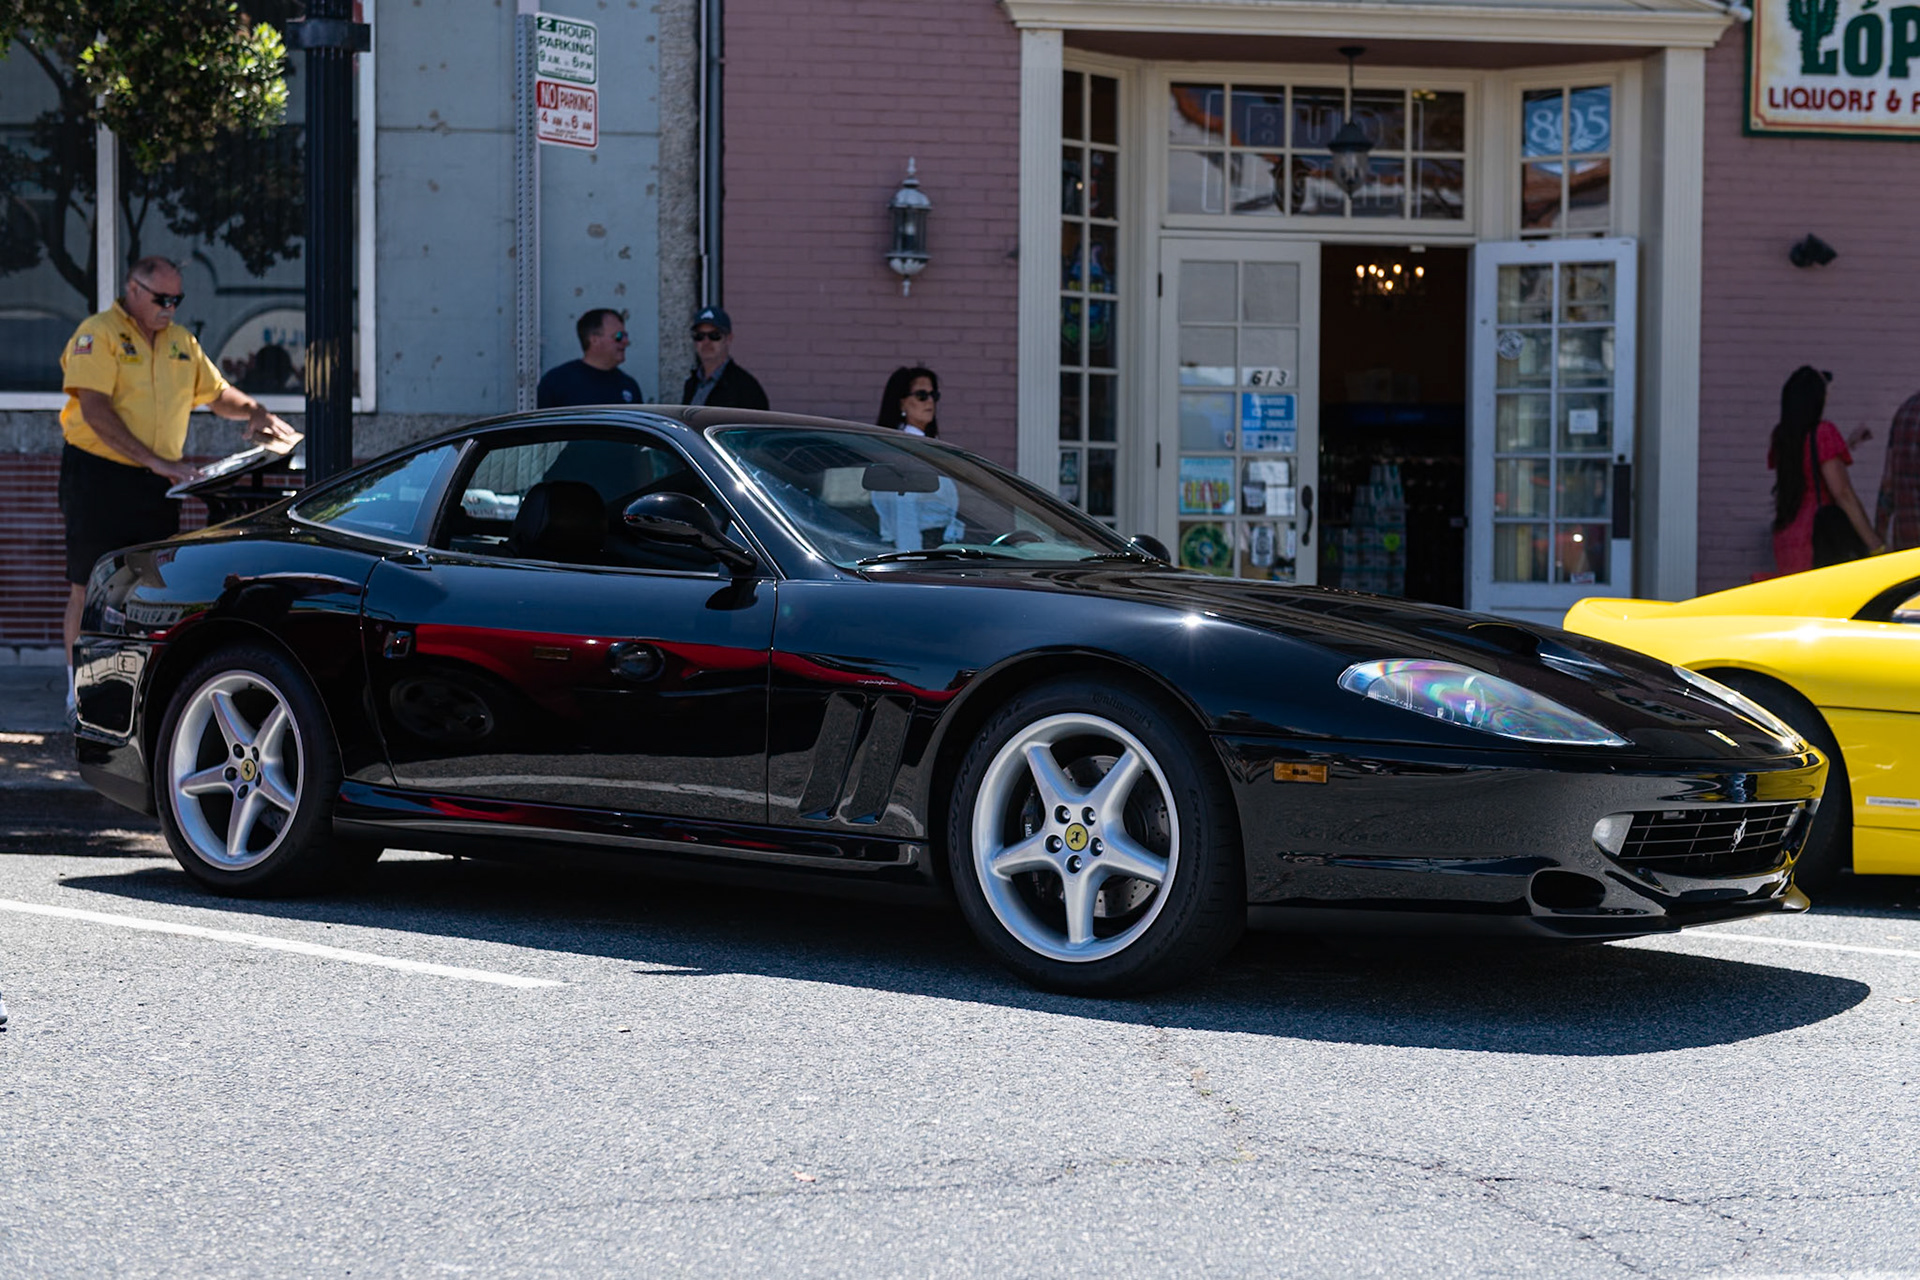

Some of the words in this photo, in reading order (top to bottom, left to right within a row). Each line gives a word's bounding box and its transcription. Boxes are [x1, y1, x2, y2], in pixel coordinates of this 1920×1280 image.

[541, 18, 552, 30] 2
[558, 24, 592, 39] HOUR
[539, 36, 593, 55] PARKING
[541, 83, 556, 108] NO
[560, 91, 592, 112] PARKING
[1768, 87, 1876, 112] LIQUORS
[1886, 89, 1902, 113] &
[541, 111, 548, 123] 4
[571, 115, 578, 129] 6
[1530, 105, 1609, 143] 805
[1252, 370, 1287, 386] 613
